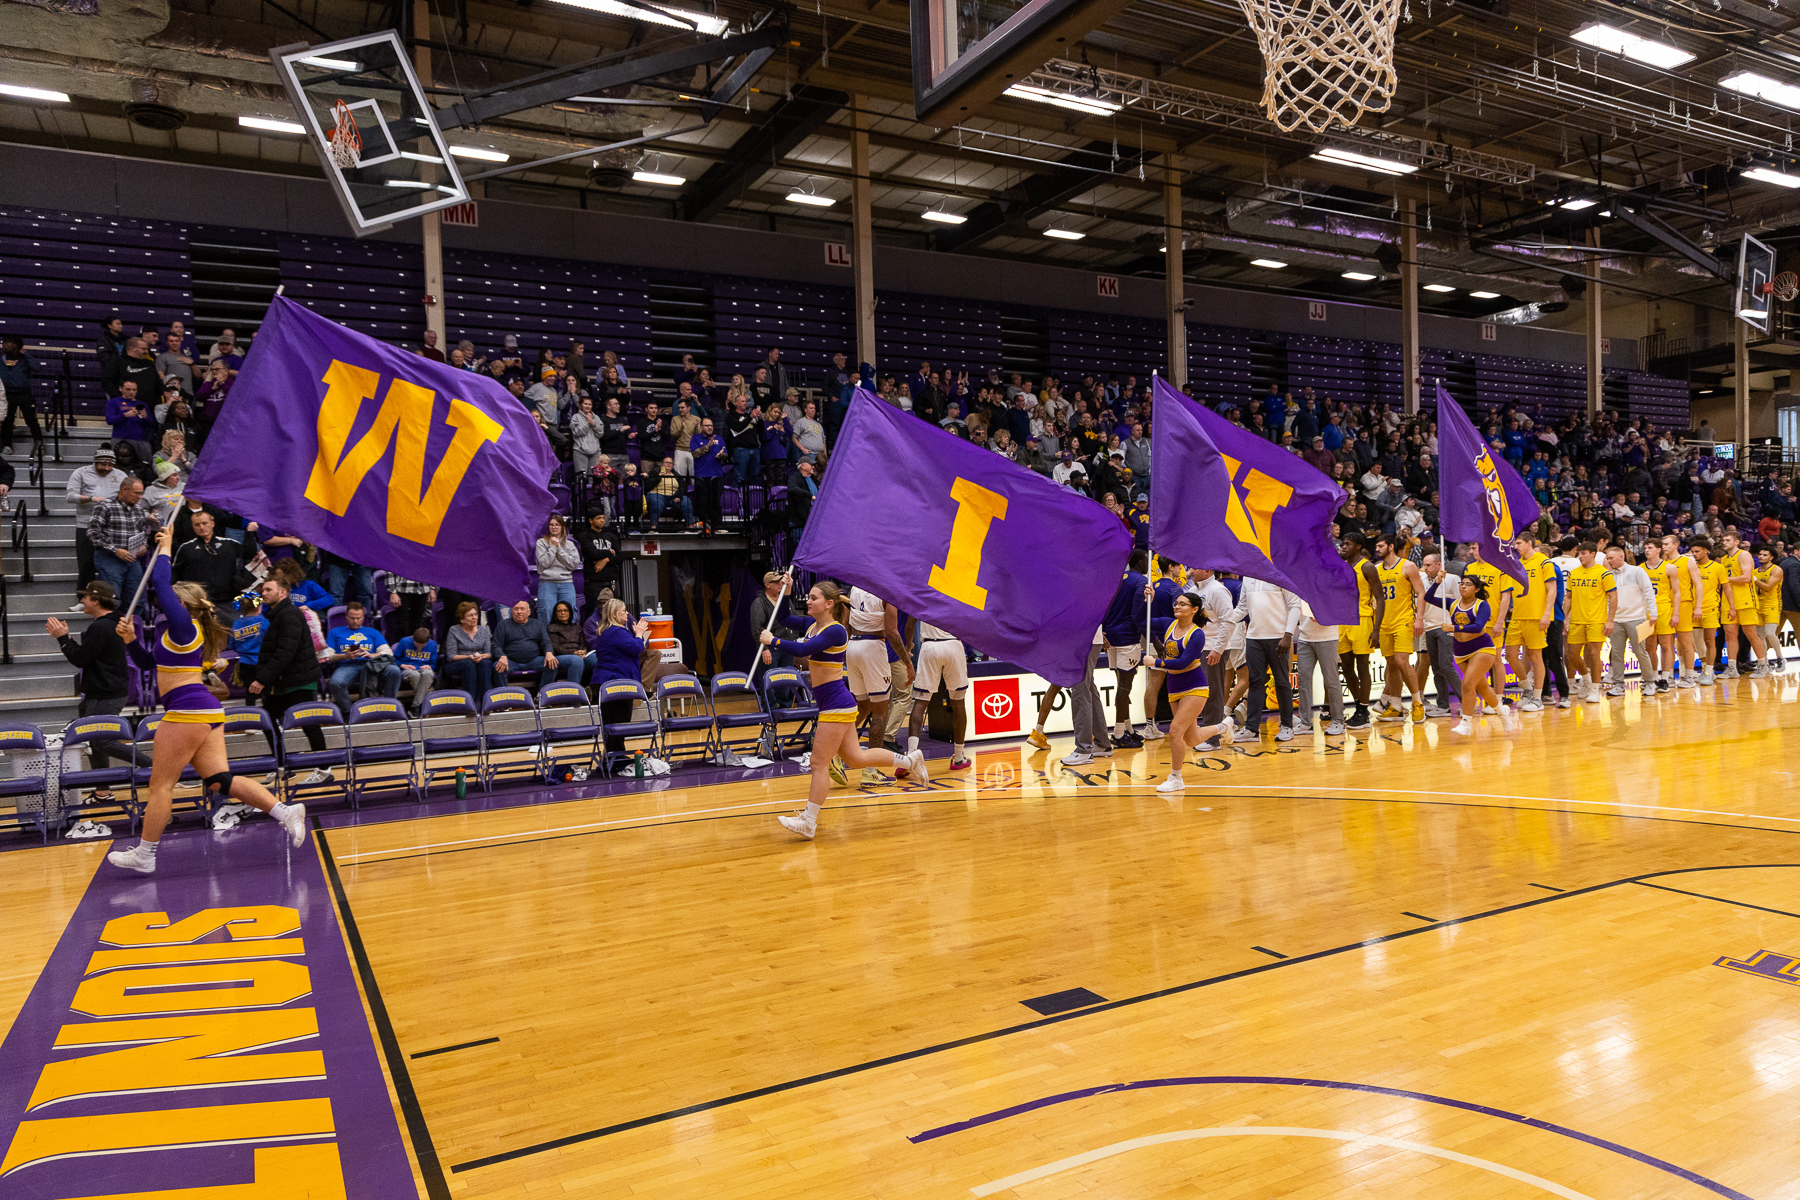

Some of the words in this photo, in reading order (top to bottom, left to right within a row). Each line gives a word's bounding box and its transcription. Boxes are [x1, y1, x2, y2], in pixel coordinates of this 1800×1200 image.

[444, 203, 476, 224] MM
[828, 245, 850, 265] LL
[1100, 277, 1118, 295] KK
[1311, 304, 1324, 319] JJ
[305, 359, 504, 547] W
[927, 476, 1009, 611] I
[1571, 578, 1598, 587] STATE
[405, 648, 431, 659] SDSU
[717, 677, 747, 687] WESTERN
[769, 673, 798, 683] WESTERN
[605, 684, 638, 695] WESTERN
[663, 680, 694, 690] WESTERN
[490, 692, 526, 703] WESTERN
[546, 688, 579, 698] WESTERN
[430, 696, 466, 707] WESTERN
[1031, 685, 1132, 713] TOT
[292, 708, 334, 720] WESTERN
[358, 703, 397, 714] WESTERN
[74, 723, 121, 735] WESTERN
[0, 730, 34, 741] STERN
